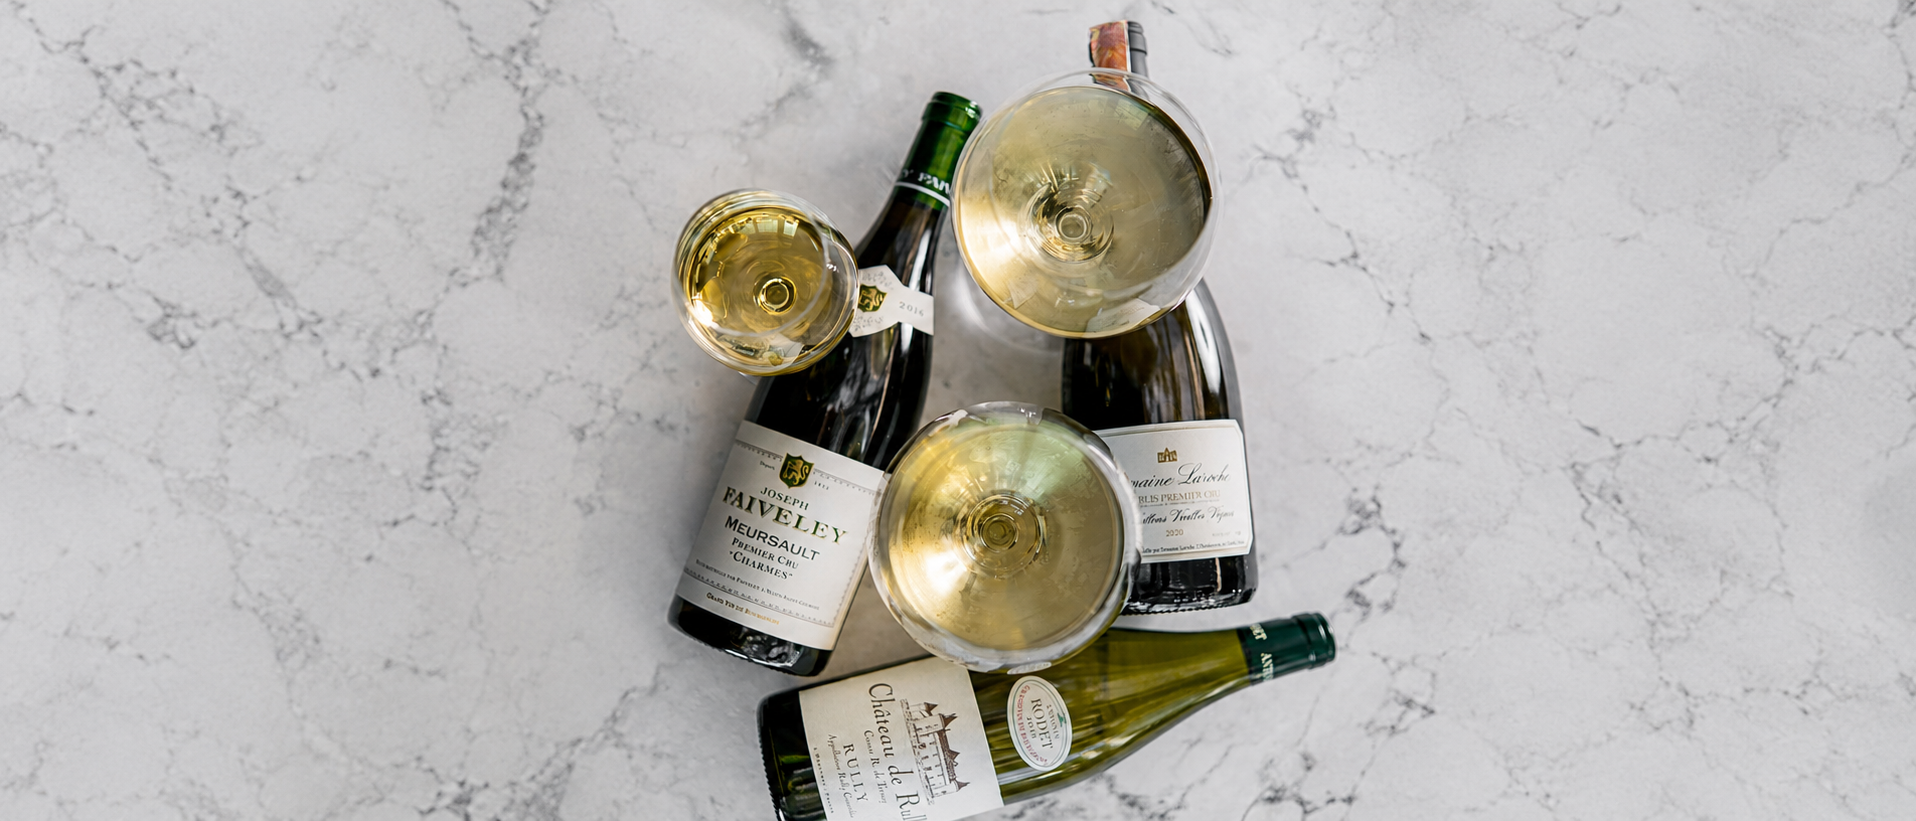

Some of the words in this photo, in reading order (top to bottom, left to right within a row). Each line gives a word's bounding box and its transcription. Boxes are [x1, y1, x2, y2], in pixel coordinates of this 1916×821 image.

[899, 301, 925, 317] 2016
[1131, 474, 1175, 488] maine
[1177, 462, 1230, 485] Laroche
[760, 487, 809, 510] JOSEPH
[1161, 491, 1202, 502] PREMIER
[722, 486, 847, 545] FAIVELEY
[724, 515, 821, 561] MEURSAULT
[1165, 529, 1184, 537] 2020
[731, 537, 775, 561] PREMIER
[777, 555, 799, 570] CRU
[868, 683, 896, 759] Château
[887, 765, 914, 786] de
[1031, 698, 1054, 749] RODET
[843, 743, 868, 801] RULLY
